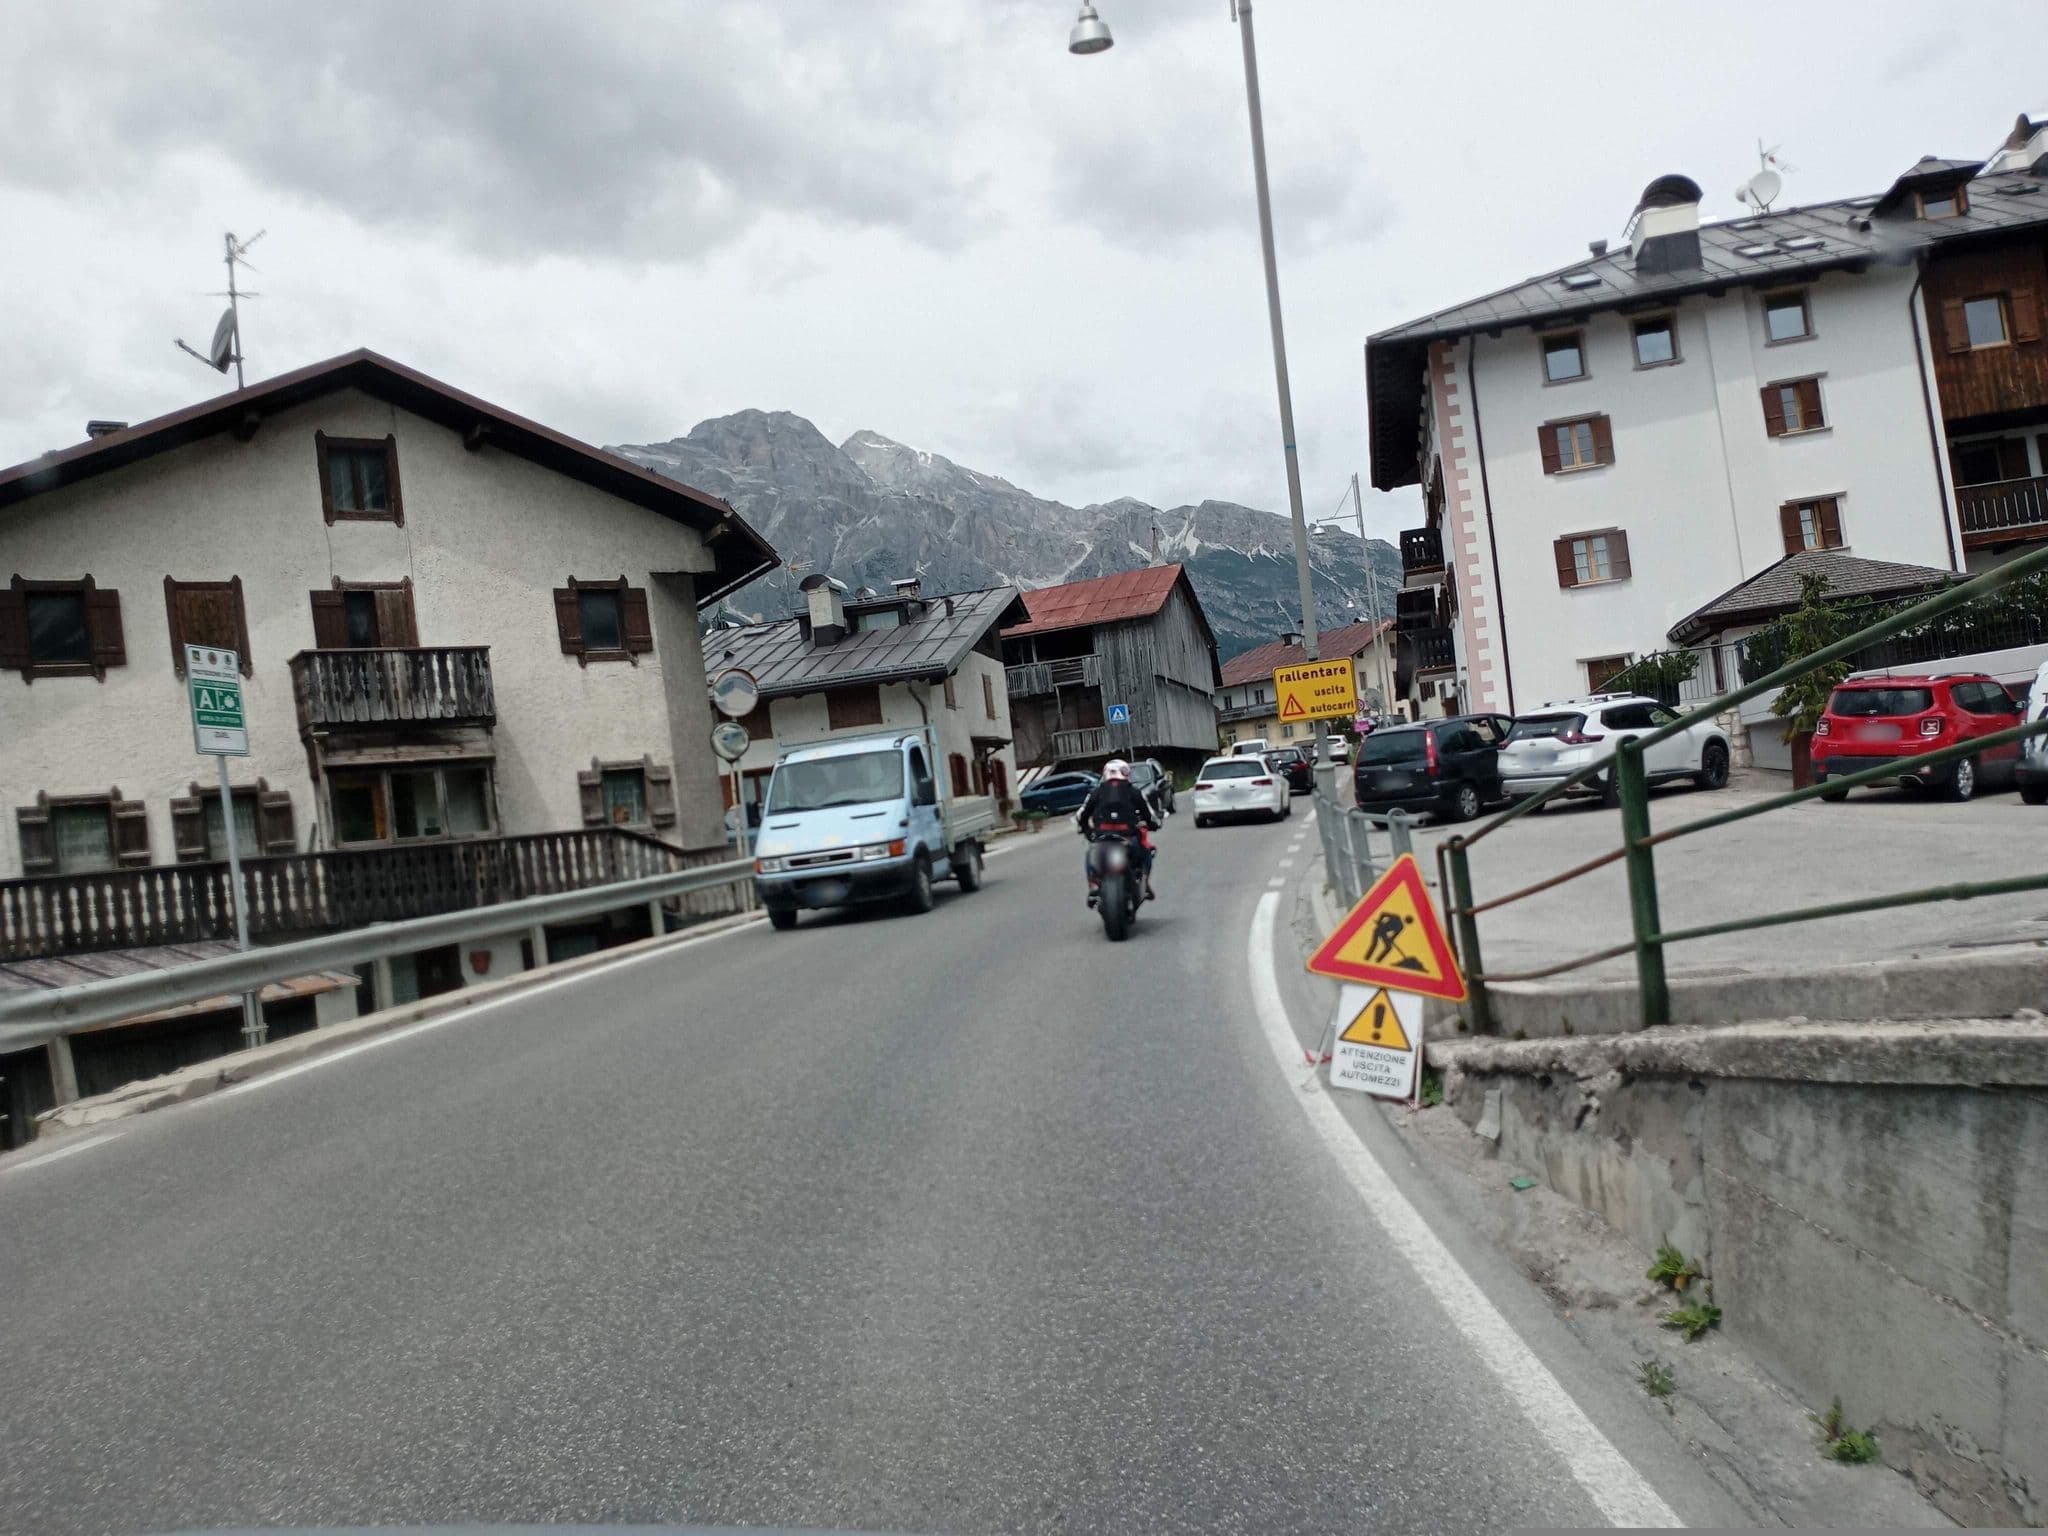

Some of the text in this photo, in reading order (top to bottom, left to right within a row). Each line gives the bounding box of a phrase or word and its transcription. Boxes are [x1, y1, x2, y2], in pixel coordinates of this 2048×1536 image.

[1279, 666, 1347, 683] rallentare
[199, 689, 214, 709] A
[1314, 685, 1346, 697] uscita
[1310, 699, 1354, 713] autocarri
[1341, 1047, 1407, 1065] ATTENZIONE
[1352, 1059, 1391, 1074] USCITA
[1339, 1070, 1401, 1087] AUTOMEZZI
